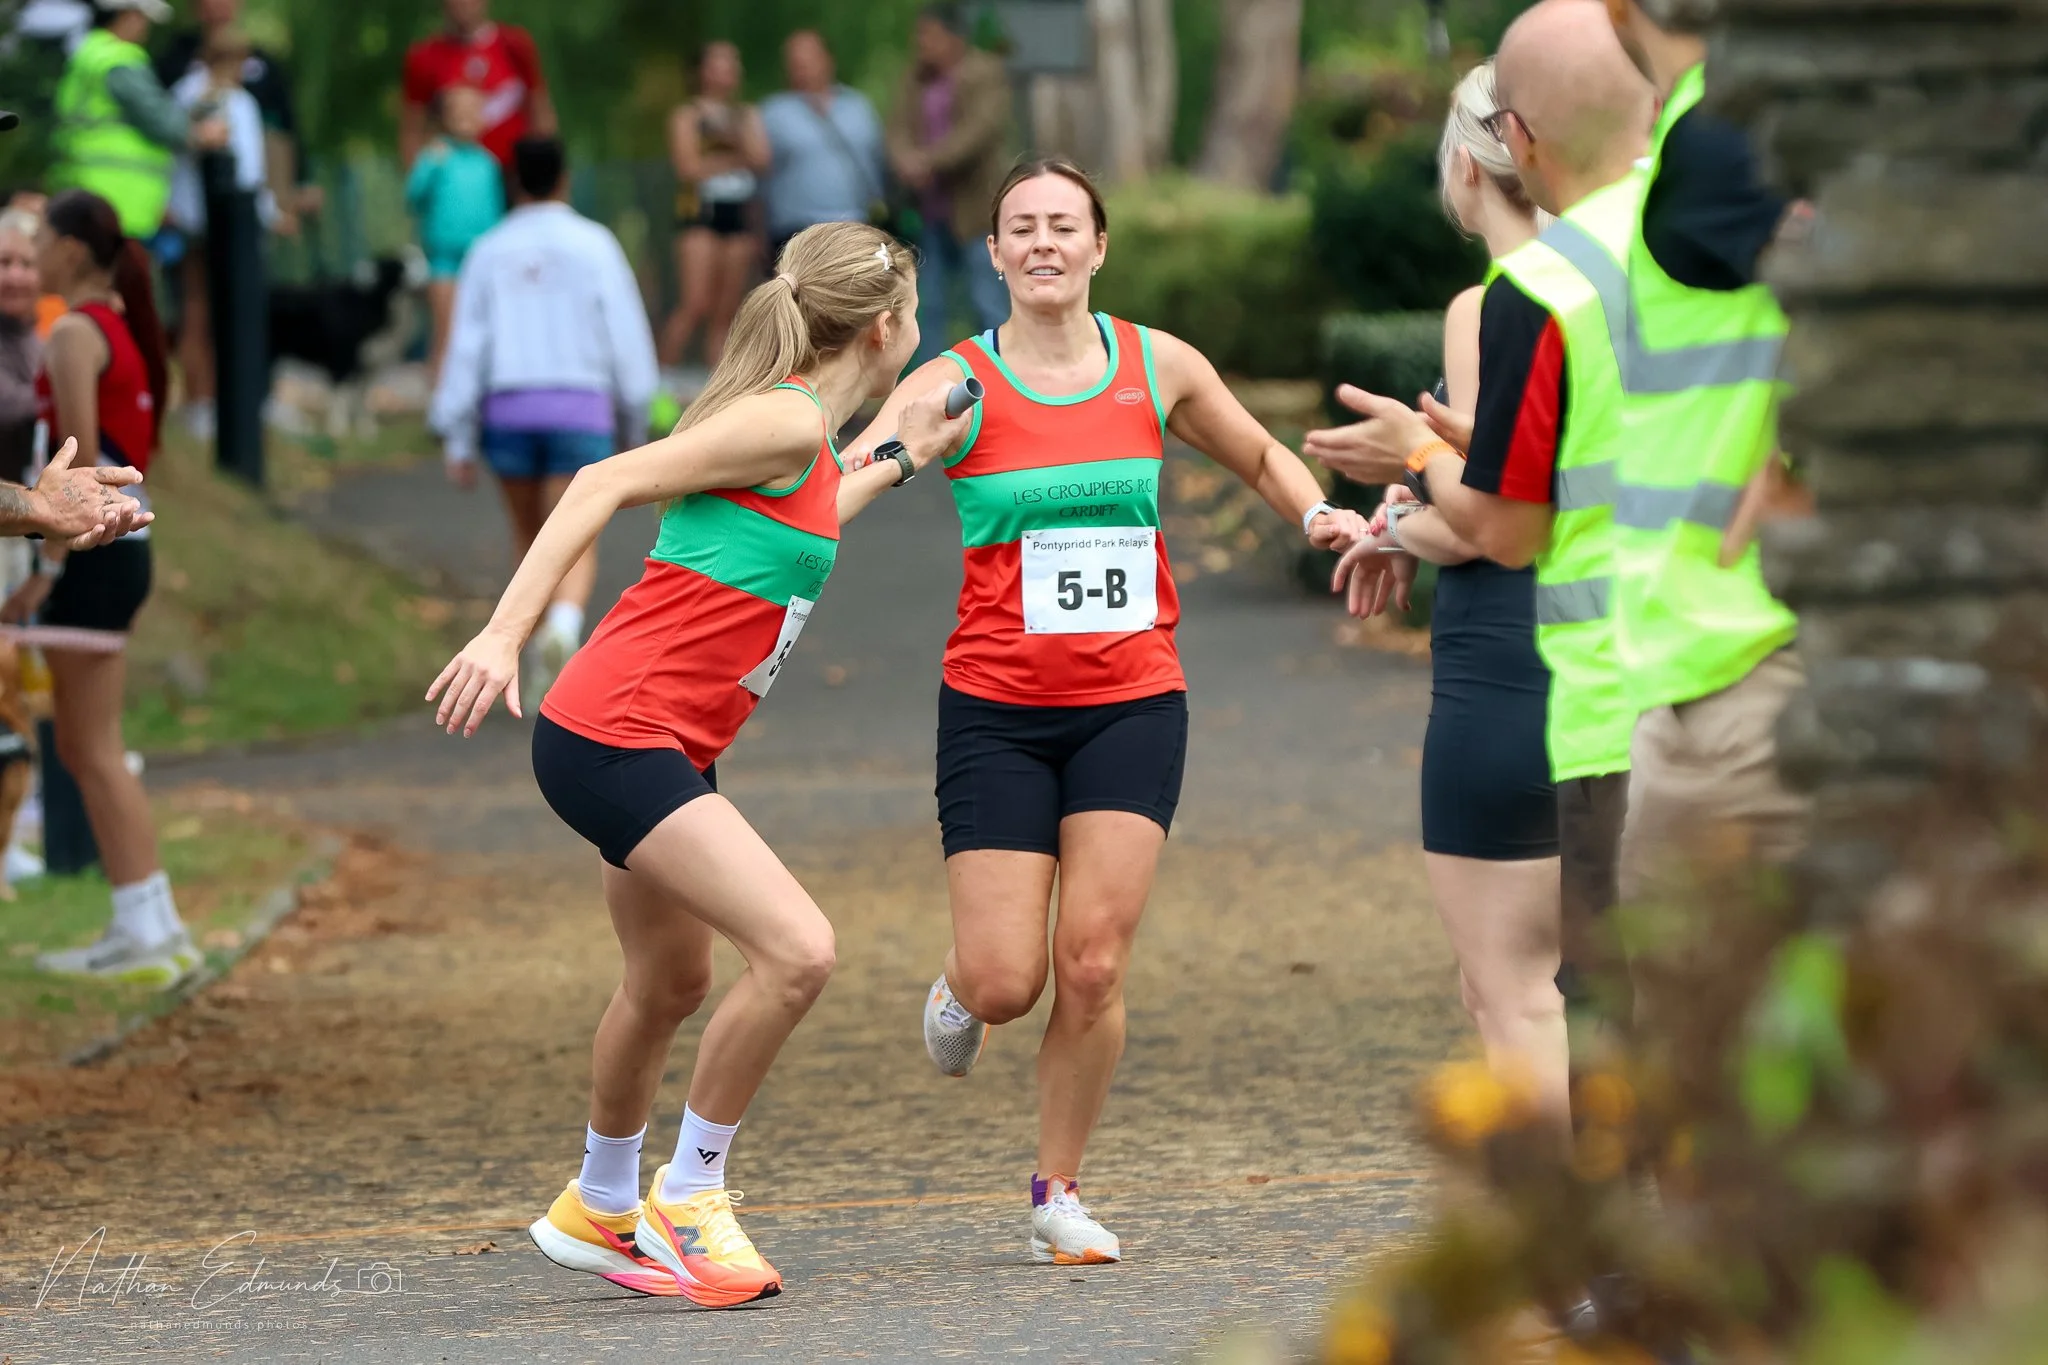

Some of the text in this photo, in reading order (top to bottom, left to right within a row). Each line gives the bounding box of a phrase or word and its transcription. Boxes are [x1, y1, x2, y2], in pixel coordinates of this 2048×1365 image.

[1013, 488, 1043, 505] LES
[1047, 479, 1133, 501] CROUPIERS
[1058, 503, 1119, 518] CARDIFF
[1033, 537, 1149, 552] Pontypridd Park Relays
[796, 550, 823, 570] LES
[1057, 568, 1128, 611] 5-B
